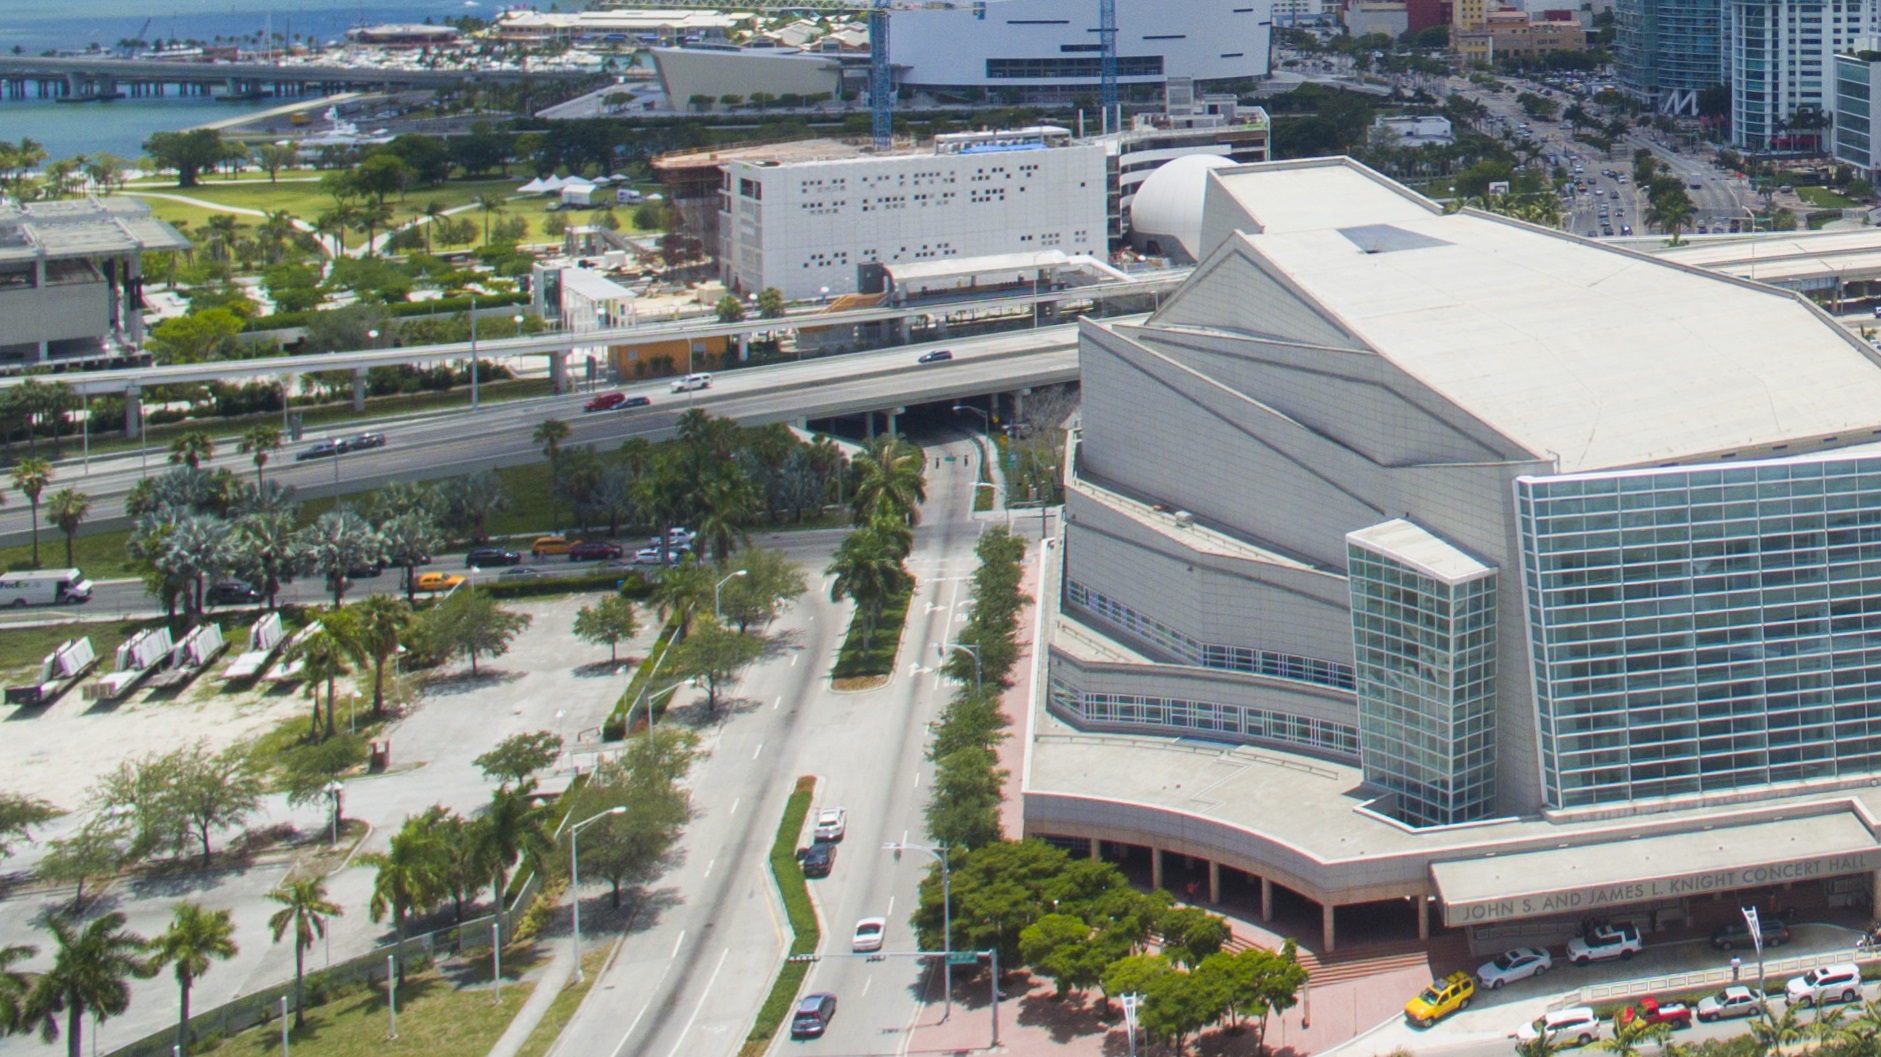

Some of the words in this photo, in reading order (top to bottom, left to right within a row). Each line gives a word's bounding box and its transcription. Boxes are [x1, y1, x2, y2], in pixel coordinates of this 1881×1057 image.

[1463, 901, 1514, 921] JOHN
[1522, 898, 1536, 913] S.
[1542, 893, 1582, 911] AND
[1589, 883, 1645, 905] JAMES
[1652, 882, 1664, 895] L.
[1669, 871, 1735, 895] KNIGHT
[1742, 859, 1822, 884] CONCERT
[1829, 854, 1867, 873] HALL
